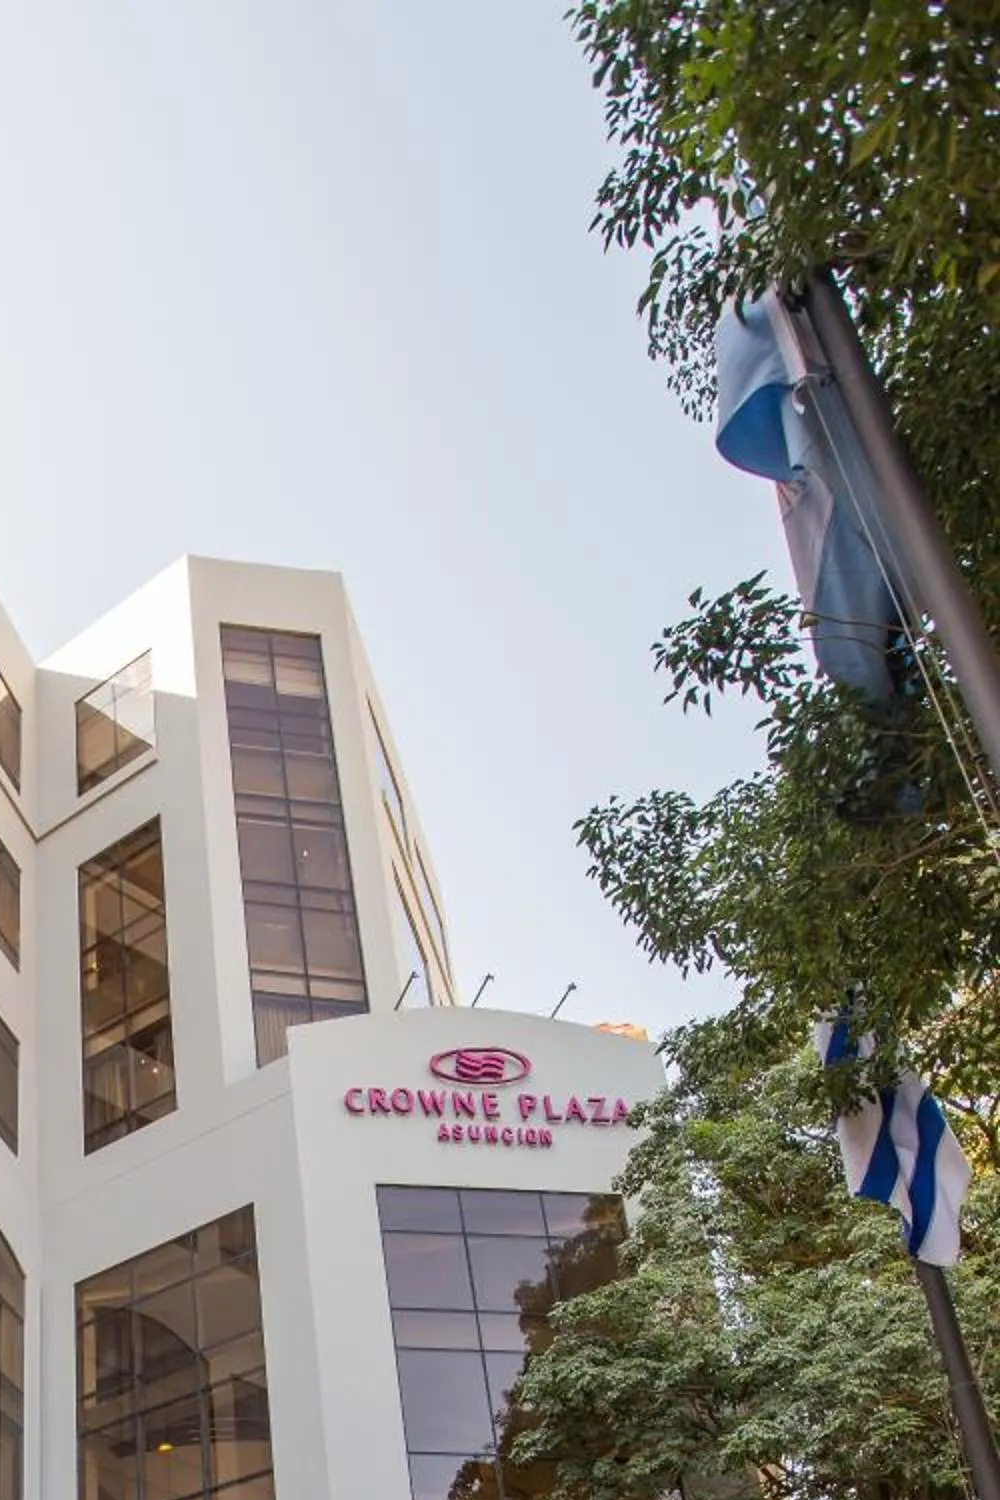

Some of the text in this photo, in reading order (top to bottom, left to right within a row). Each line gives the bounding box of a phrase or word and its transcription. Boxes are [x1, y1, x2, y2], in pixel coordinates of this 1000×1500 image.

[344, 1087, 630, 1123] CROWNE PLAZA
[438, 1123, 552, 1147] ASUNCION
